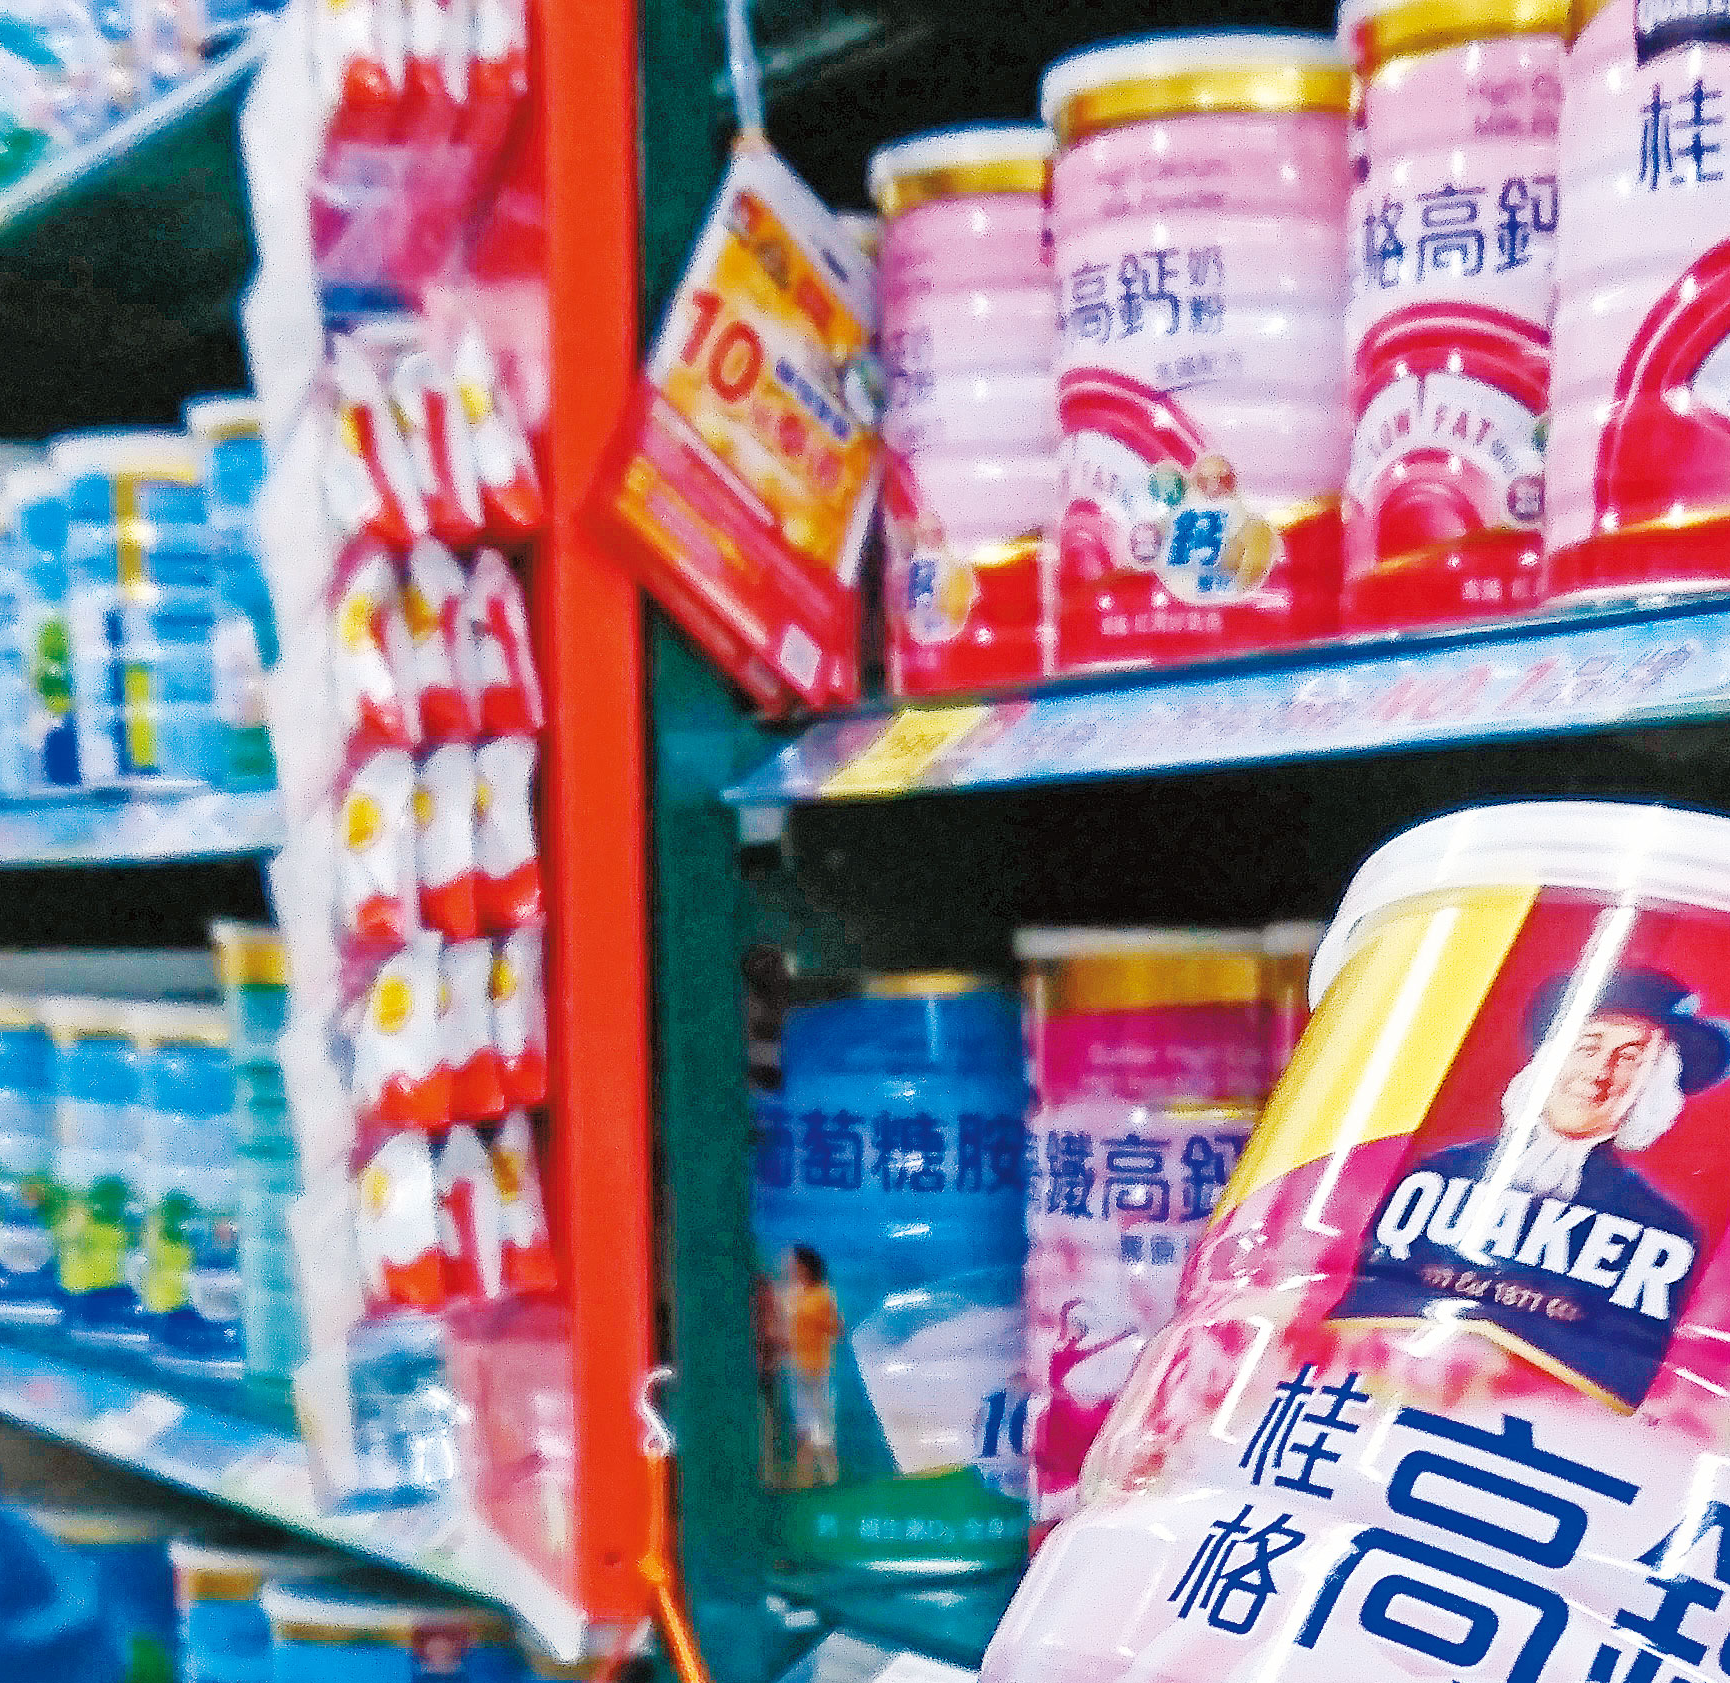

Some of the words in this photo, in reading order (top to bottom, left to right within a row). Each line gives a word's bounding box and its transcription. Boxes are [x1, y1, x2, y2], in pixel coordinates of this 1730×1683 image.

[680, 290, 764, 402] 10
[1029, 1130, 1250, 1222] 鐵高鈣
[1376, 1171, 1698, 1321] QUAKER
[1166, 1362, 1372, 1636] 桂格
